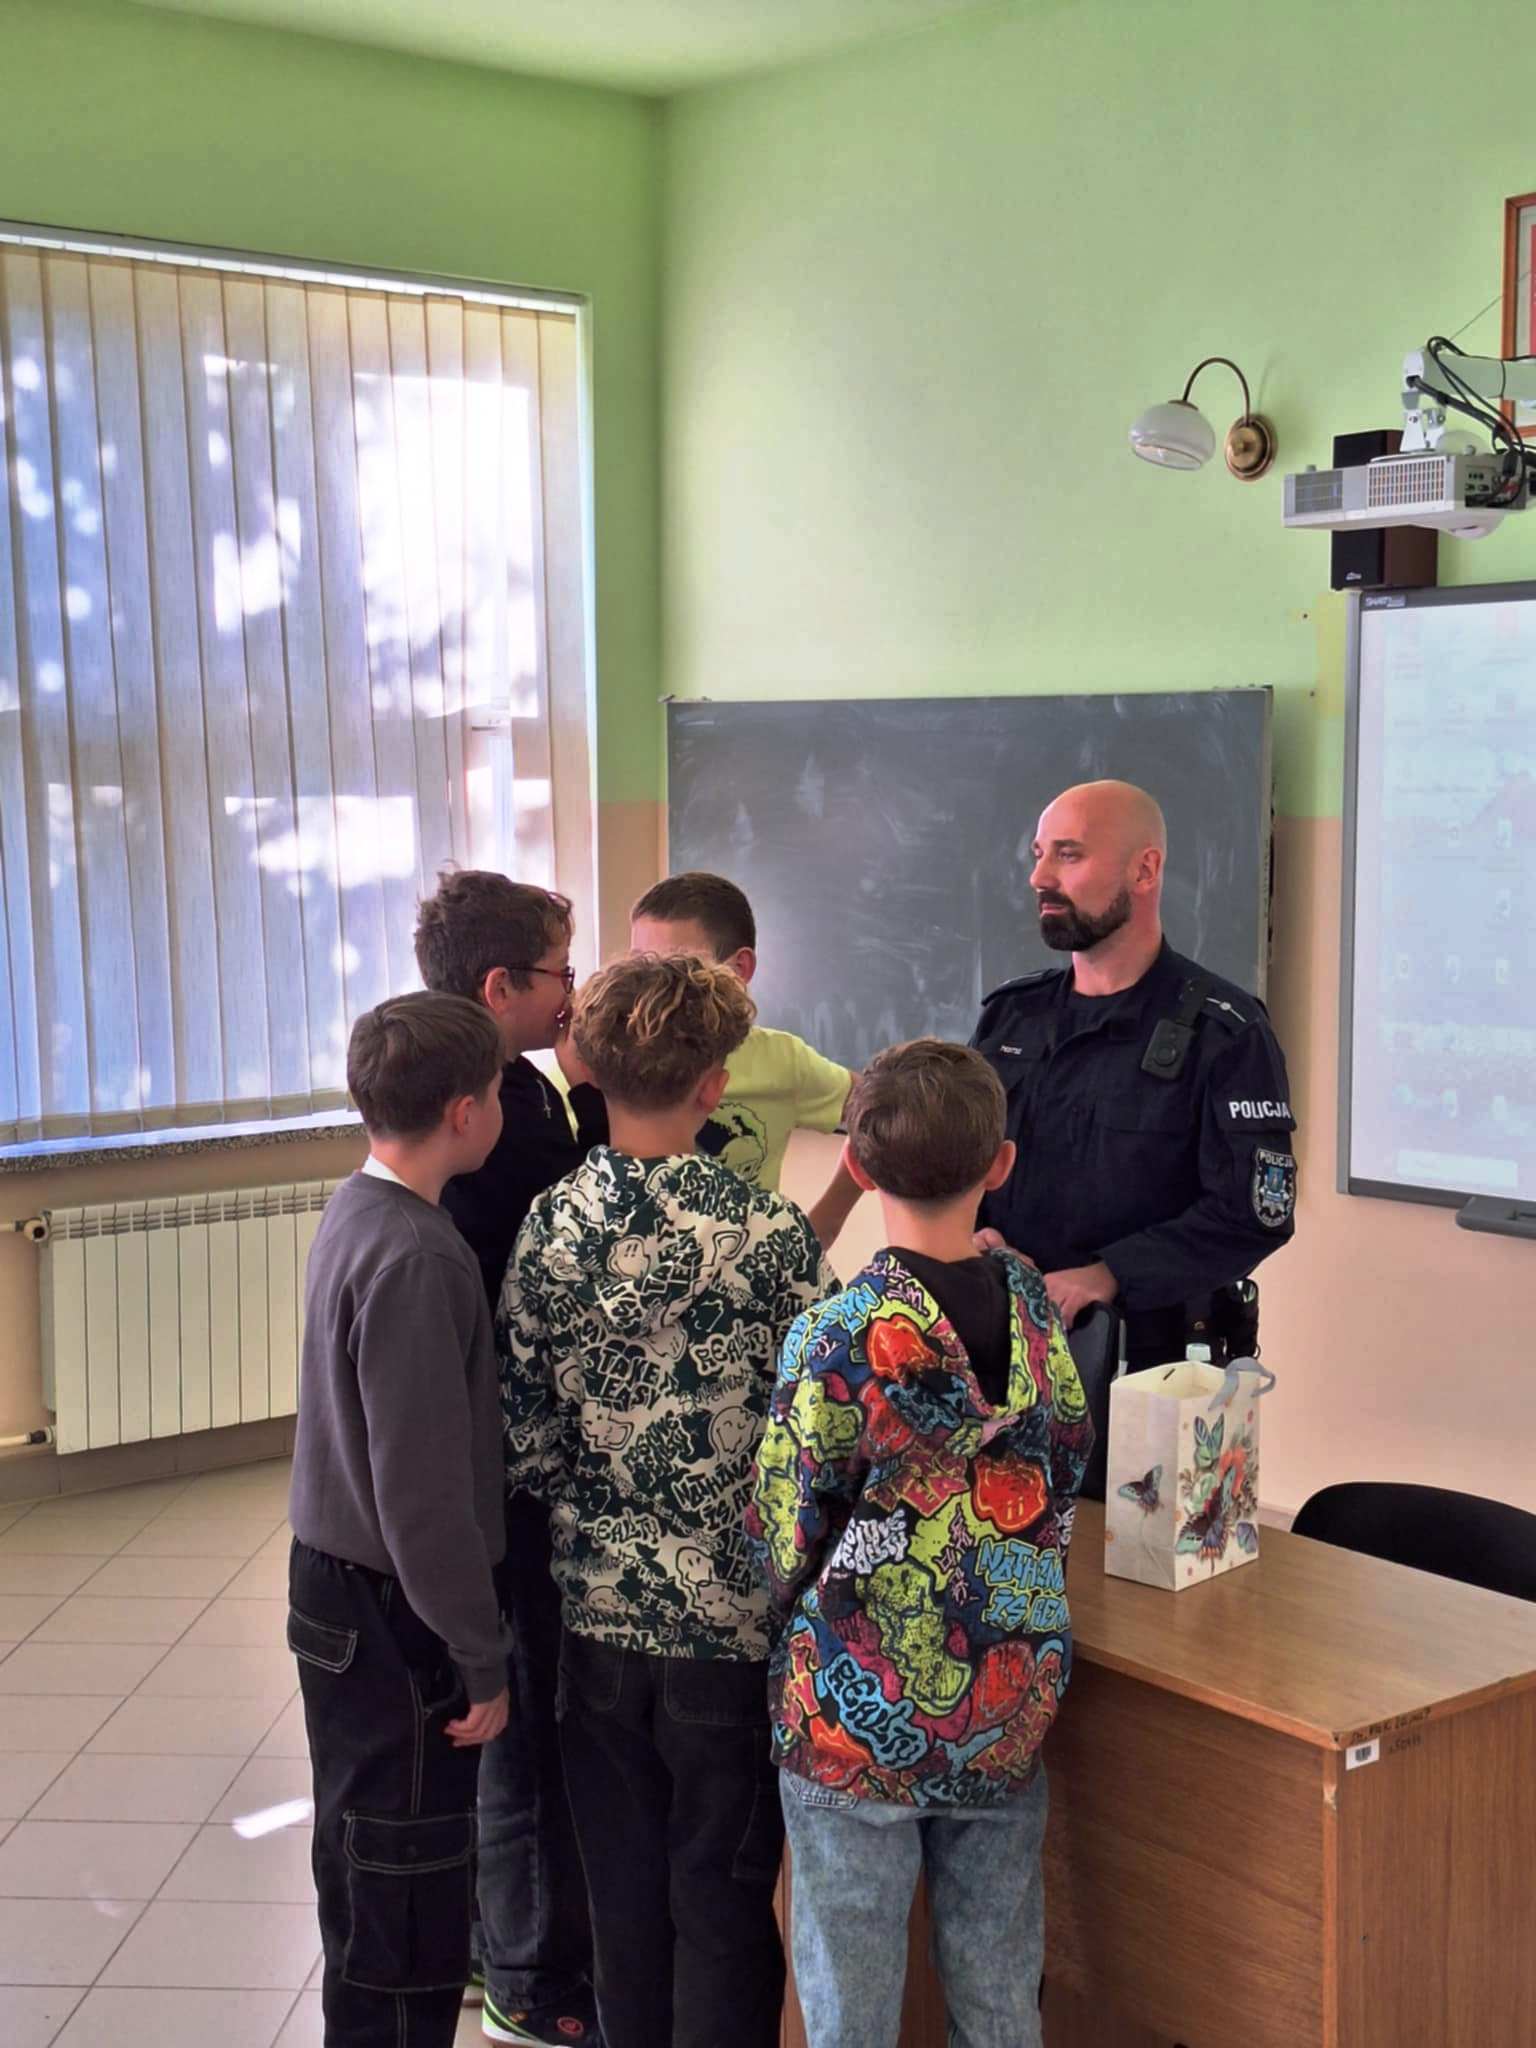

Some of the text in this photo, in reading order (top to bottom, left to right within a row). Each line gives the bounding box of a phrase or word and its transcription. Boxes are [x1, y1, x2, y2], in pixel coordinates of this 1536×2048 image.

[1229, 1101, 1291, 1118] POLICJA
[598, 1347, 660, 1387] TAKE
[977, 1538, 1065, 1594] NOTHIN
